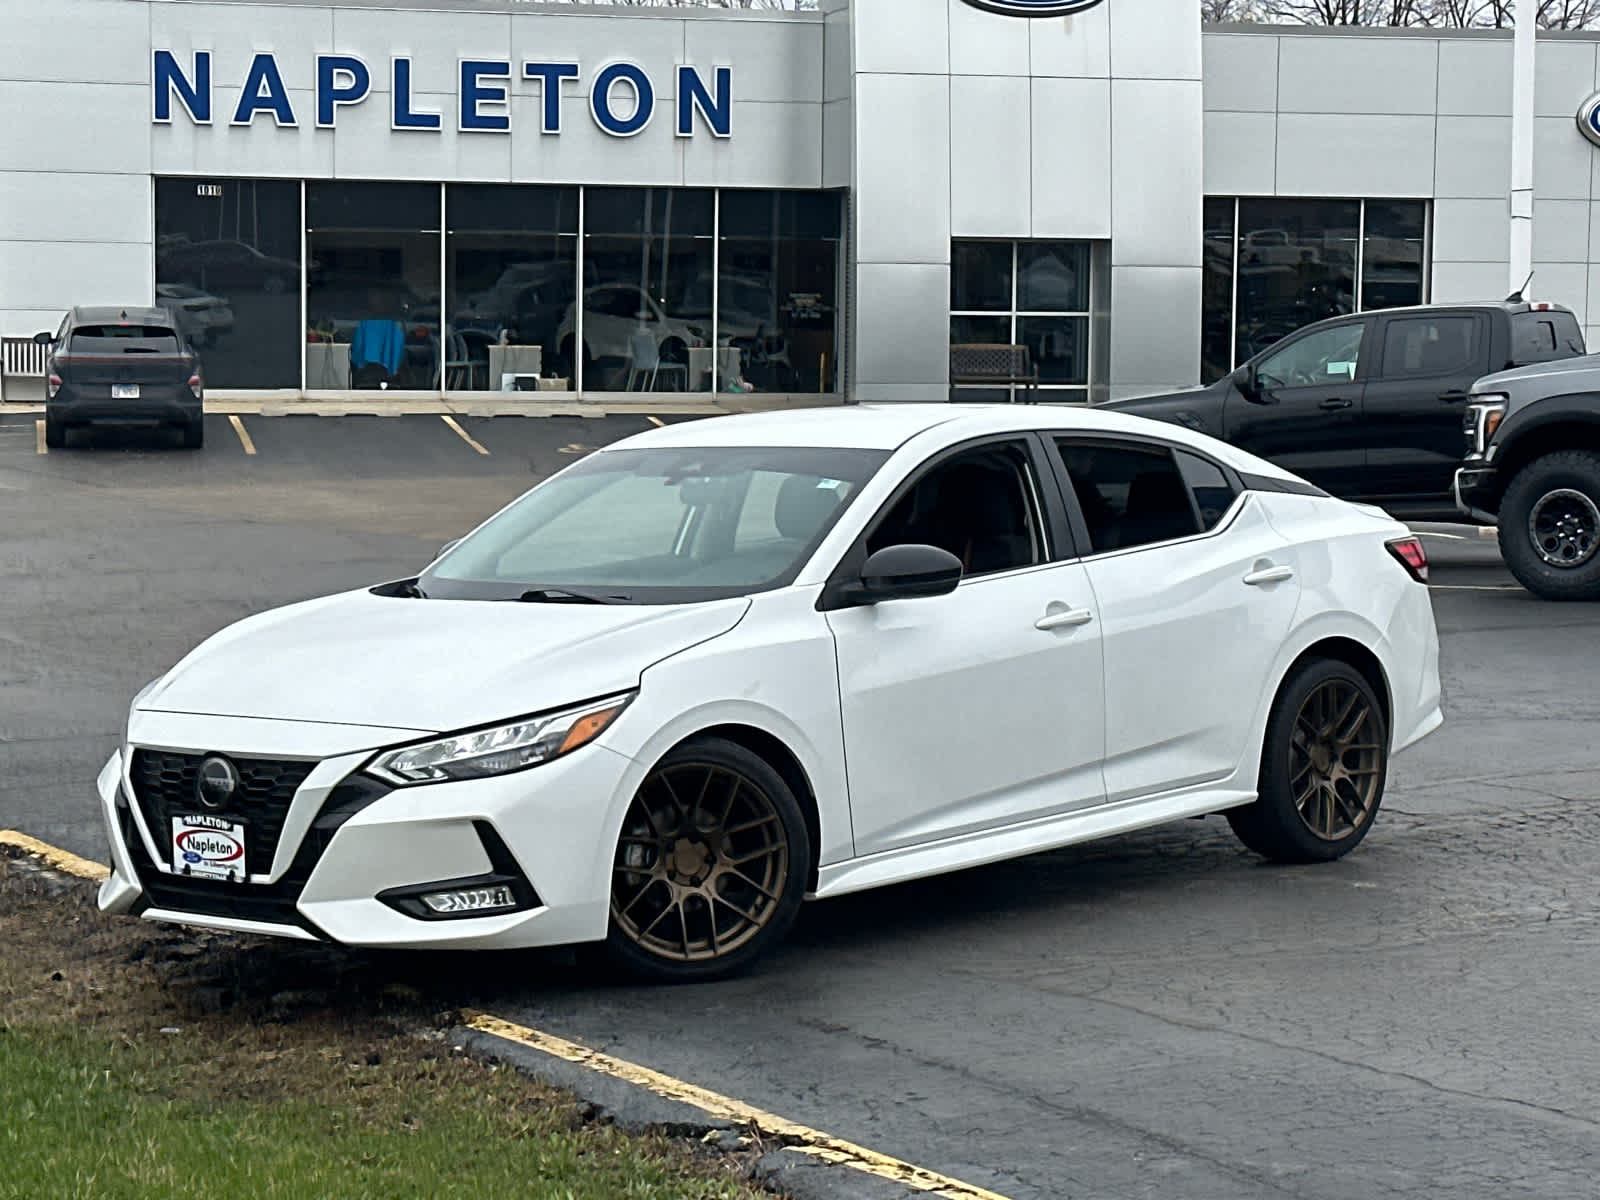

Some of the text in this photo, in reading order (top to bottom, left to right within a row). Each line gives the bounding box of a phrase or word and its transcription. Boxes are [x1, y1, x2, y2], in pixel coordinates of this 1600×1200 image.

[151, 48, 733, 138] NAPLETON
[184, 815, 230, 829] NAPLETON
[186, 835, 233, 855] Napleton
